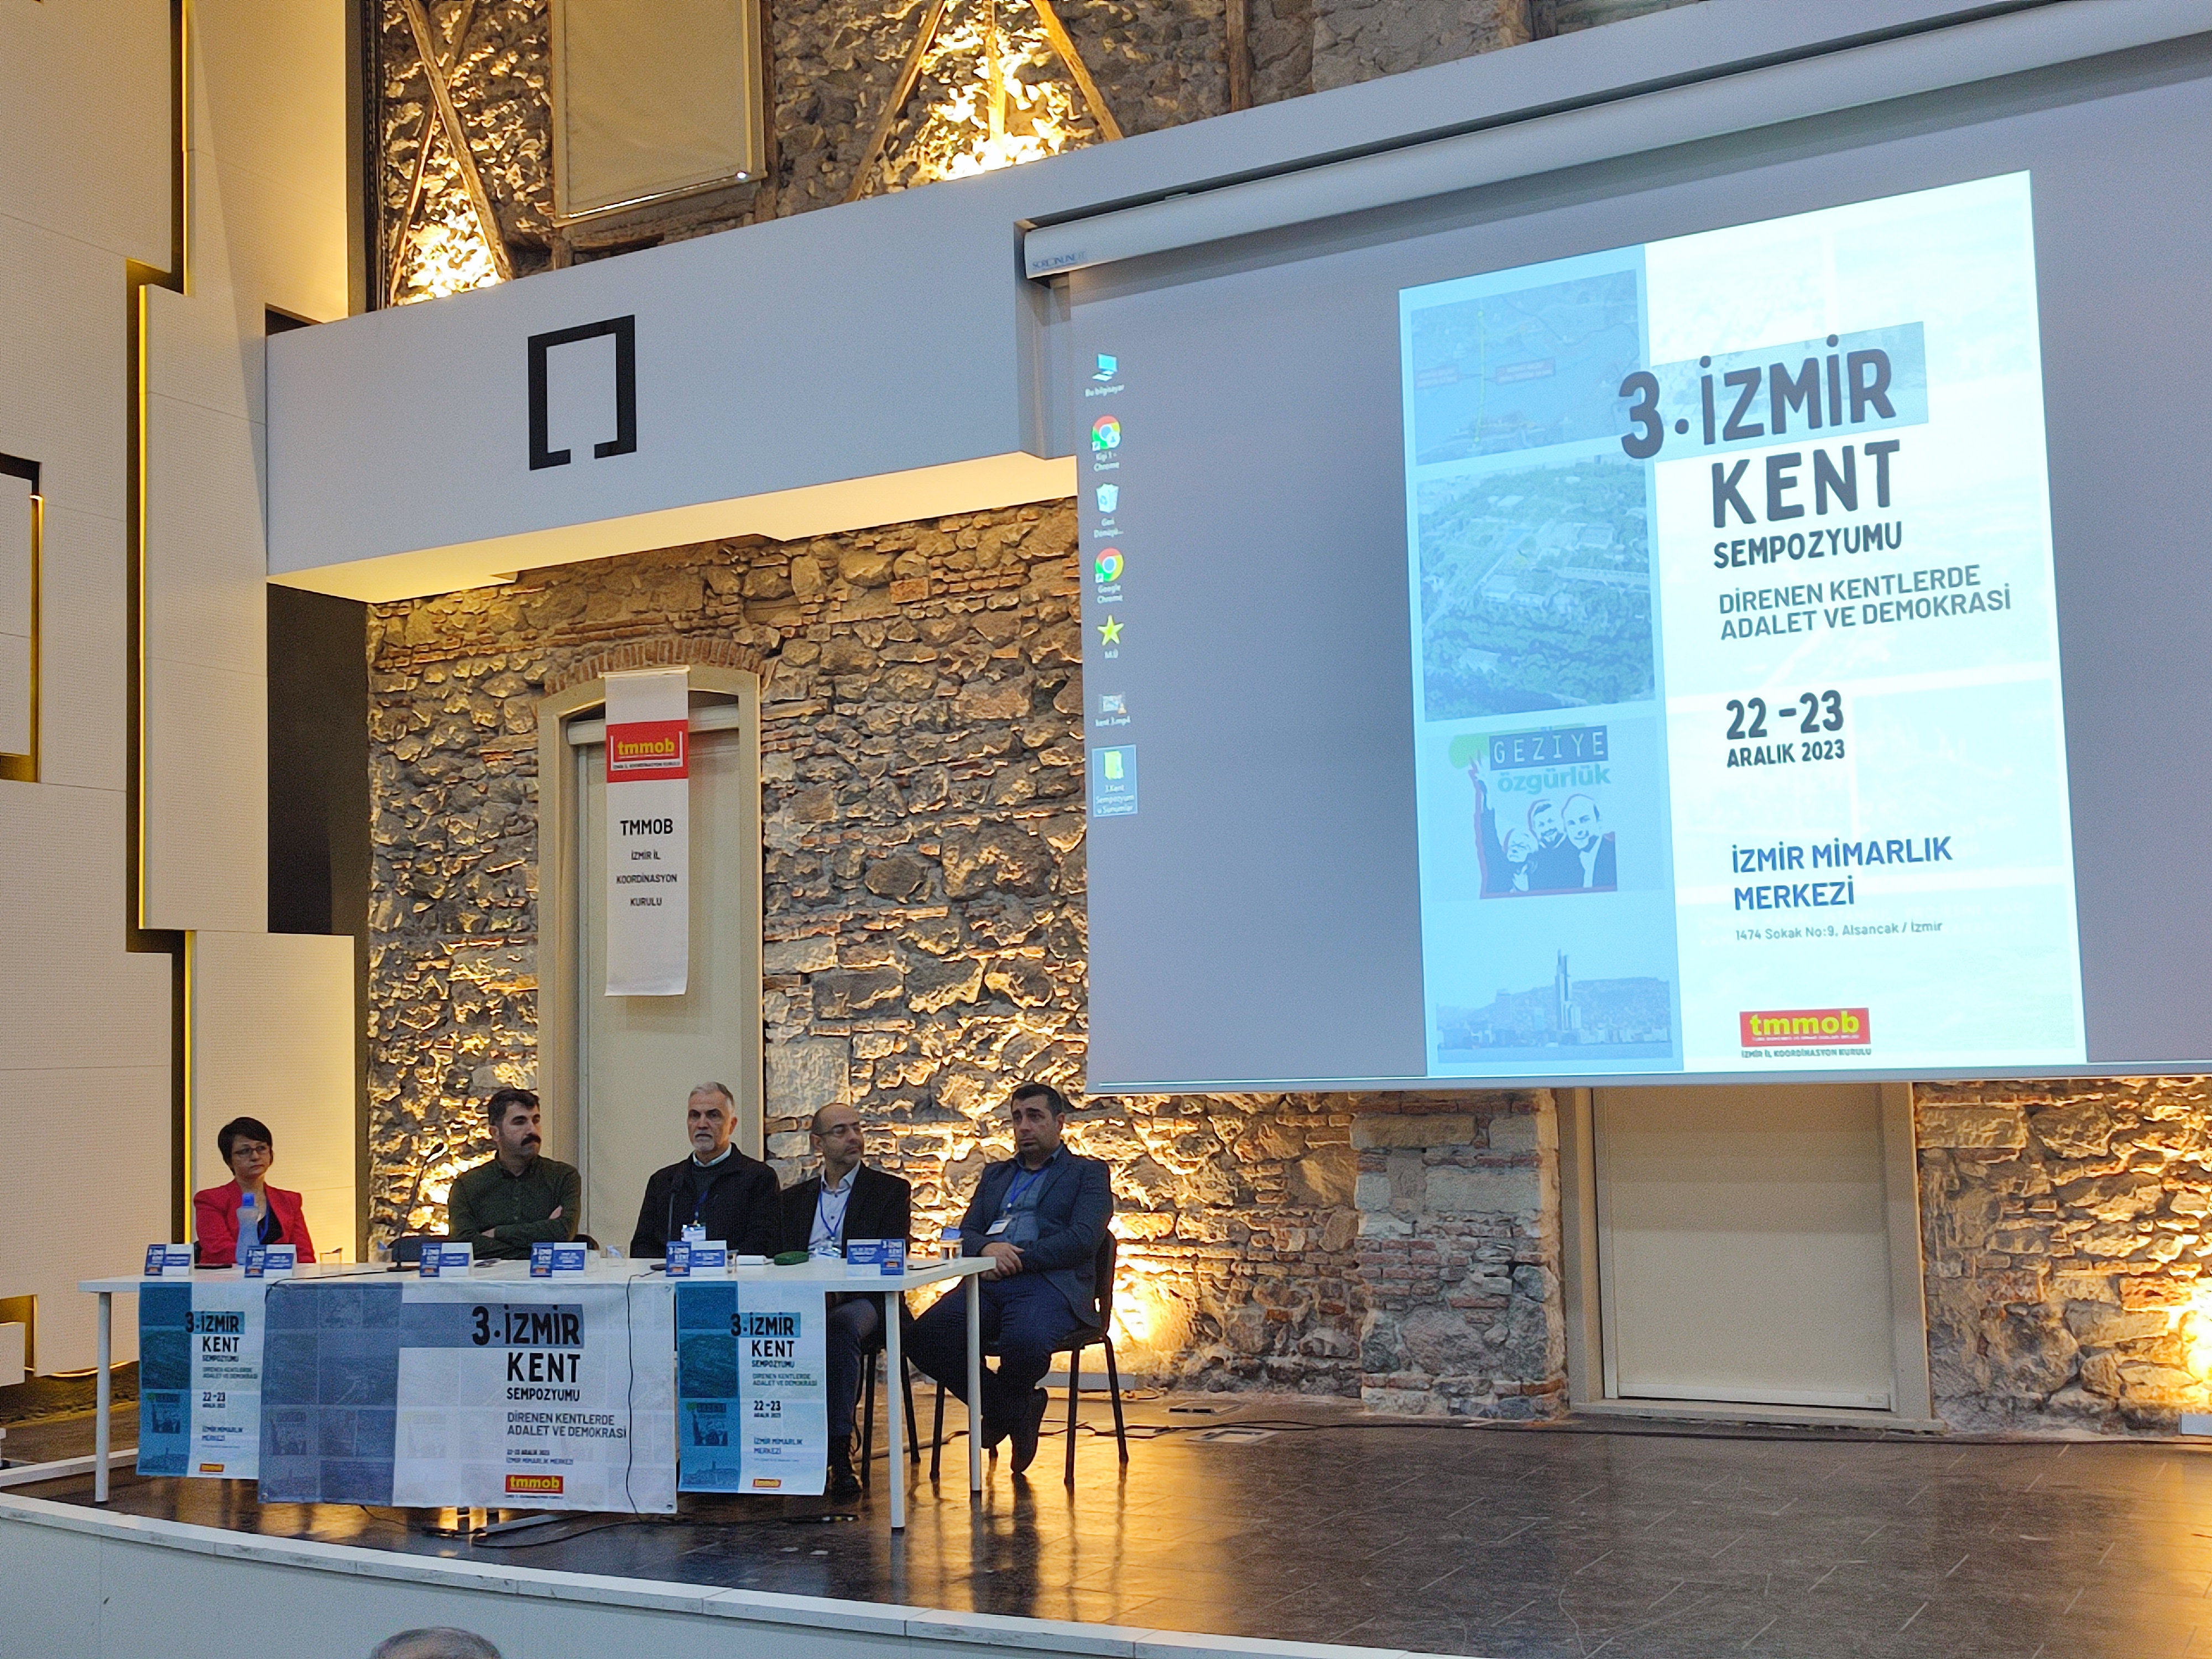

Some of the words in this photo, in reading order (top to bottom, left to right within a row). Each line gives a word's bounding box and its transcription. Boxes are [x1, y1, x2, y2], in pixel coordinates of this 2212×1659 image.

[1712, 440, 1900, 528] KENT
[1714, 521, 1902, 569] SEMPOZYUMU
[1719, 582, 1823, 614] DİRENEN
[1829, 564, 1981, 601] KENTLERDE
[1721, 610, 1817, 640] ADALET
[1824, 606, 1855, 629] VE
[1863, 583, 2011, 625] DEMOKRASİ
[618, 738, 675, 755] tmmob
[1727, 743, 1795, 768] ARALIK
[1802, 739, 1845, 762] 2023
[1498, 763, 1611, 795] özgürlük
[620, 818, 673, 836] TMMOB
[631, 849, 651, 860] İZMİR
[653, 849, 661, 860] İL
[1732, 841, 1804, 873] İZMİR
[1812, 836, 1953, 869] MİMARLIK
[616, 872, 677, 884] KOORDİNASYON
[1735, 875, 1854, 910] MERKEZİ
[630, 898, 662, 906] KURULU
[1736, 929, 1761, 940] 1474
[1765, 927, 1802, 940] Sokak
[1842, 921, 1899, 936] Alsancak
[1750, 1010, 1859, 1036] tmmob
[202, 1336, 240, 1353] KENT
[752, 1340, 795, 1357] KENT
[507, 1352, 581, 1383] KENT
[752, 1360, 795, 1368] SEMPOZYUMU
[507, 1387, 581, 1402] SEMPOZYUMU
[507, 1410, 553, 1423] DİRENEN
[555, 1413, 614, 1425] KENTLERDE
[507, 1425, 550, 1436] ADALET
[553, 1426, 566, 1437] VE
[568, 1426, 627, 1438] DEMOKRASİ
[510, 1476, 560, 1489] tmmob
